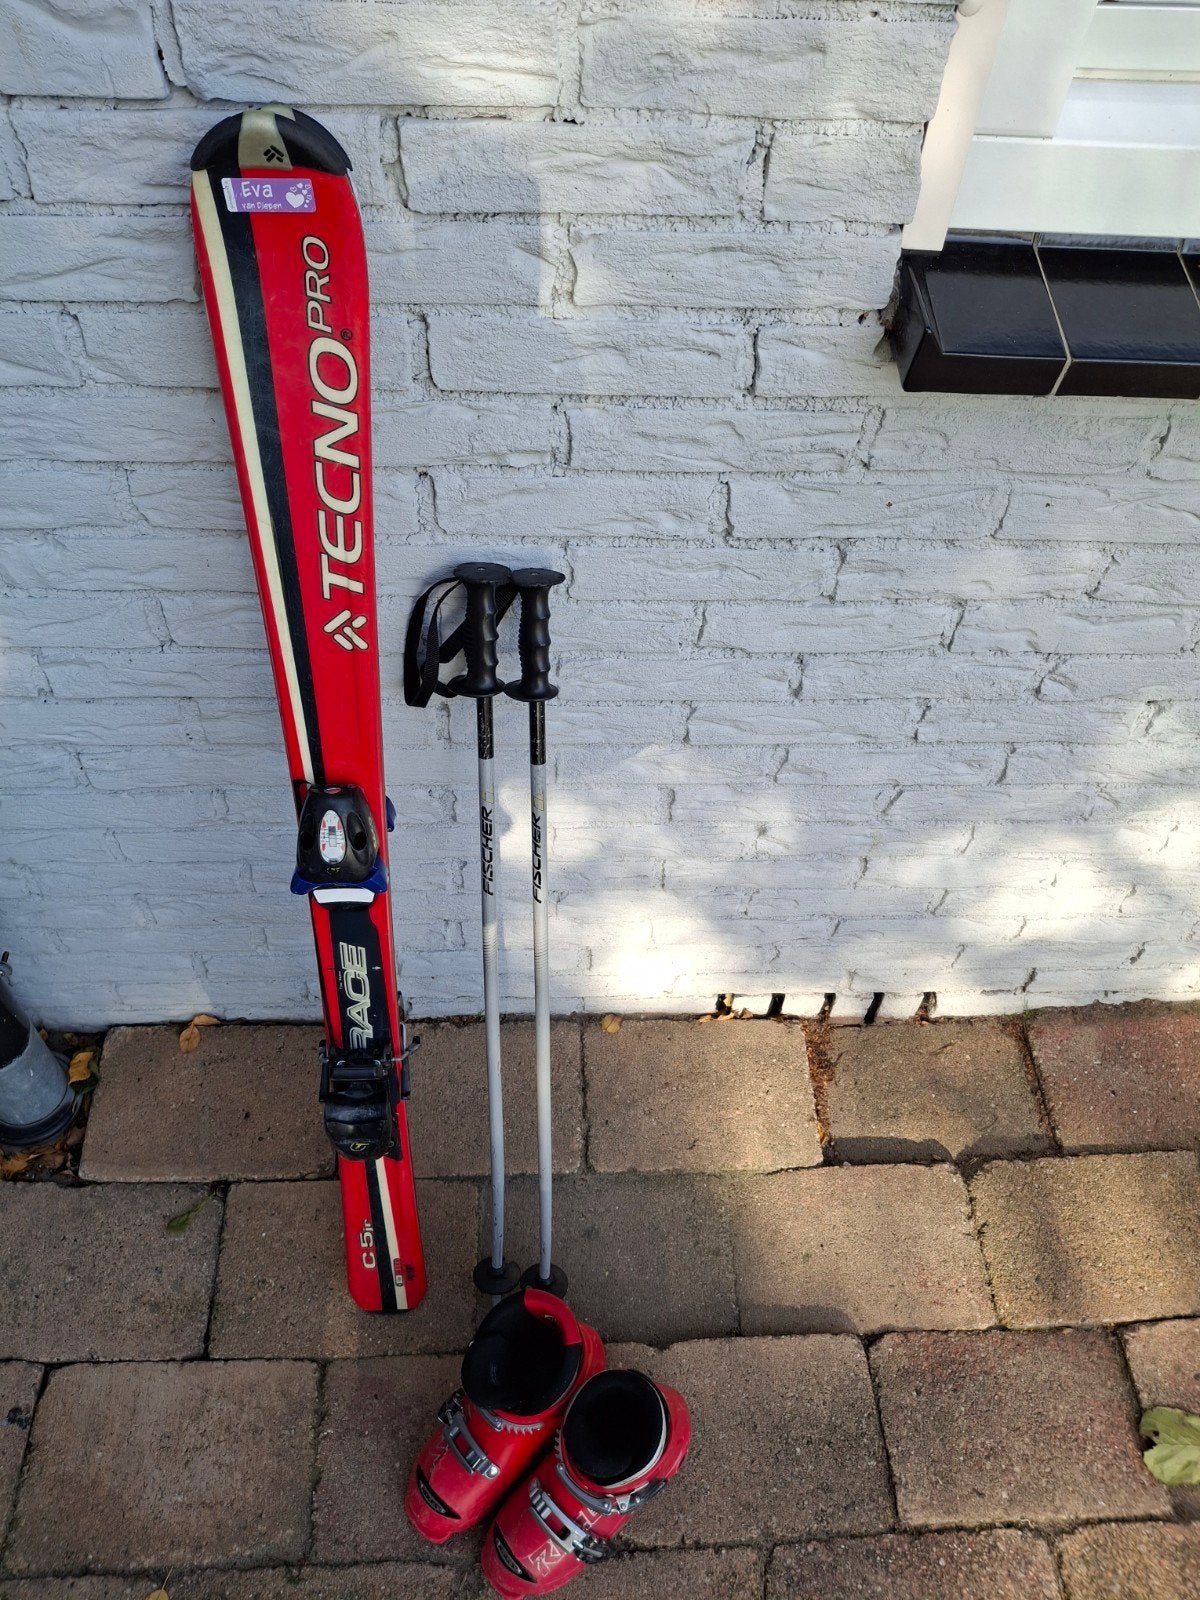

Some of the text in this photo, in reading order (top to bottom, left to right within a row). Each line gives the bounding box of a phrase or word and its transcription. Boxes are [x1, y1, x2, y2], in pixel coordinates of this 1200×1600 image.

[241, 181, 273, 198] Eva
[481, 806, 494, 896] FISCHER
[531, 811, 542, 904] FISCHER
[339, 941, 374, 1050] RACE
